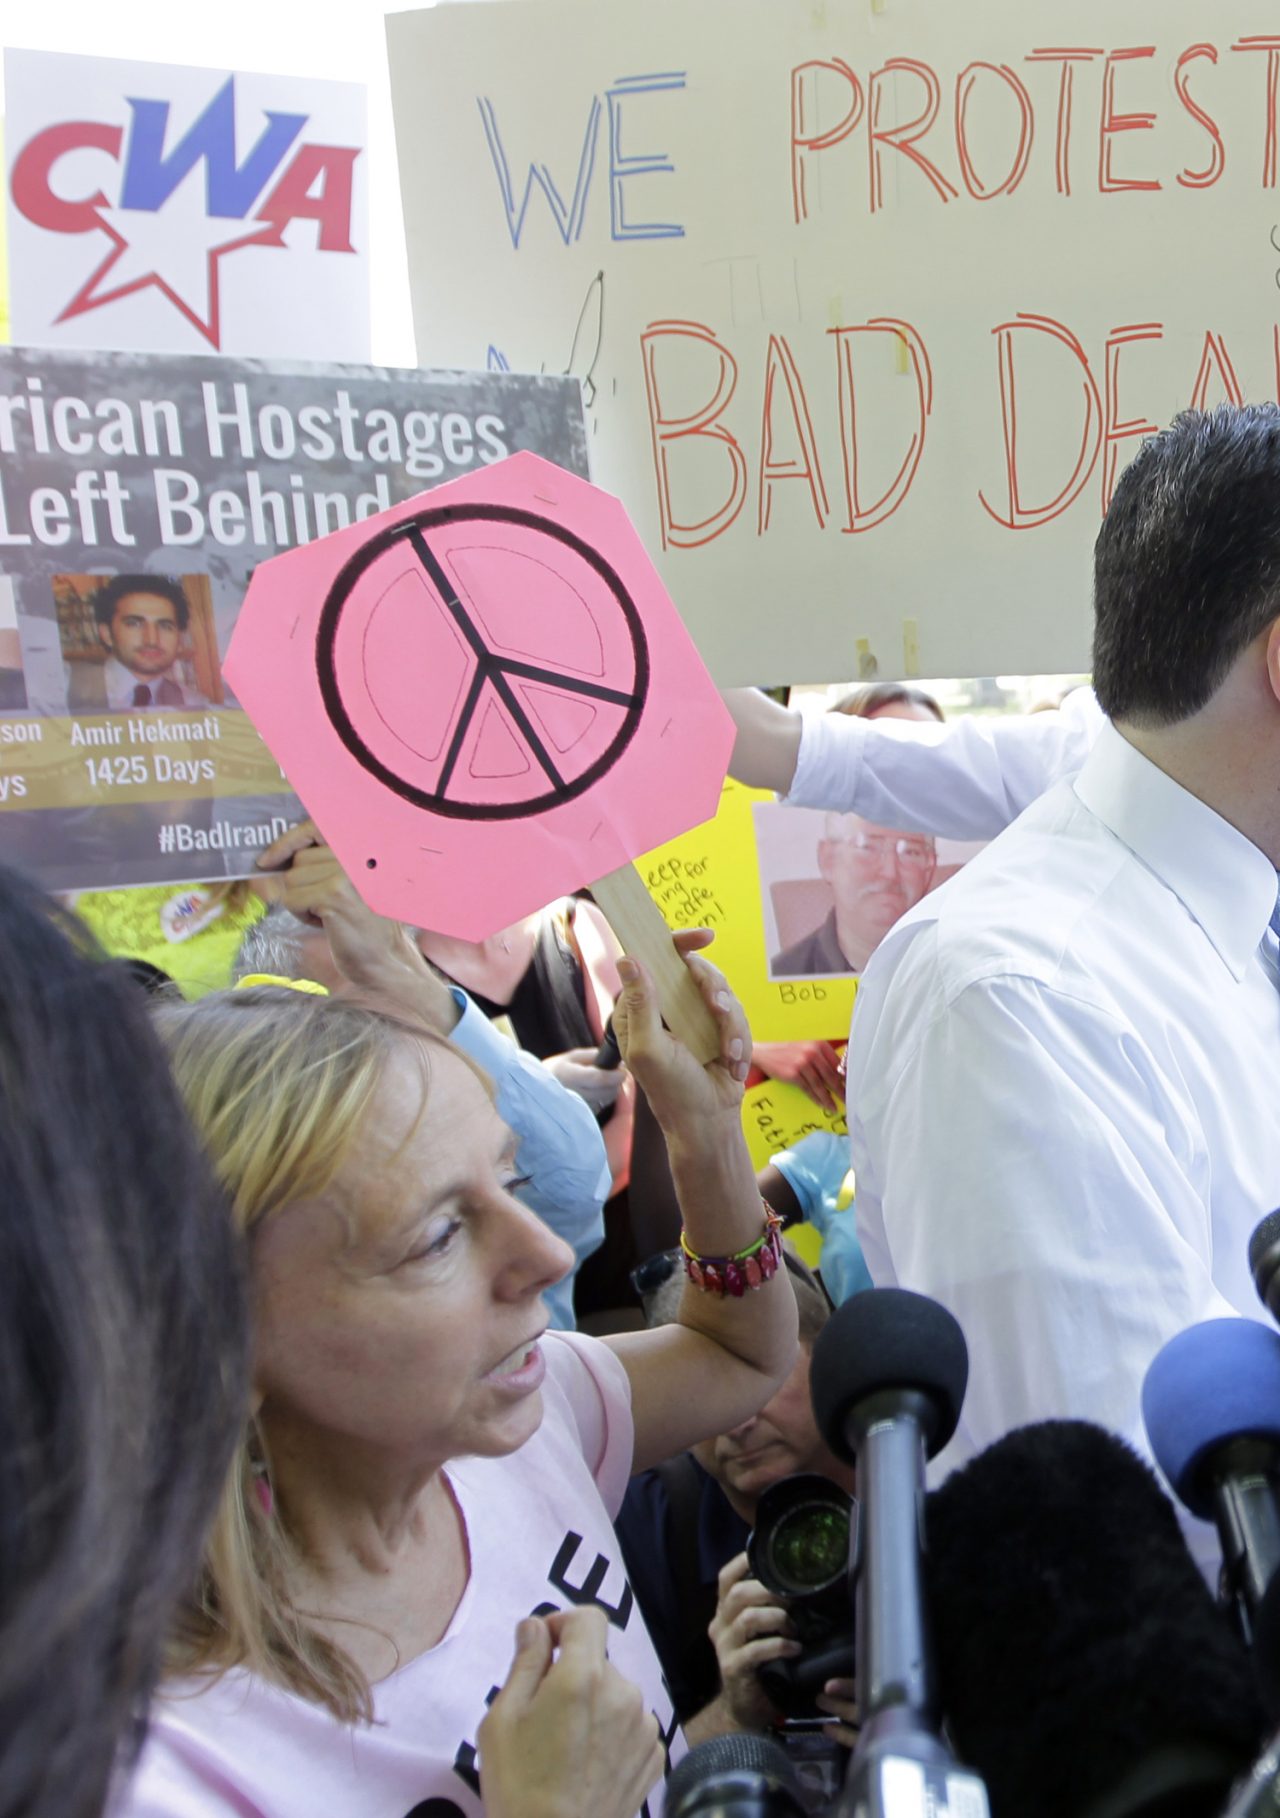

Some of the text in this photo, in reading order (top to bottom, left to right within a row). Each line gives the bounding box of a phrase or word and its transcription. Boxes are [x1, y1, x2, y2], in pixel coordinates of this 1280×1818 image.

[10, 74, 362, 254] CWA
[477, 72, 686, 249] WE
[202, 381, 509, 478] Hostages
[640, 320, 933, 552] BAD
[70, 717, 221, 747] Amir Hekmati
[85, 755, 216, 786] 1425 Days
[684, 856, 708, 879] for
[674, 887, 714, 925] safe
[779, 982, 828, 1004] Bob
